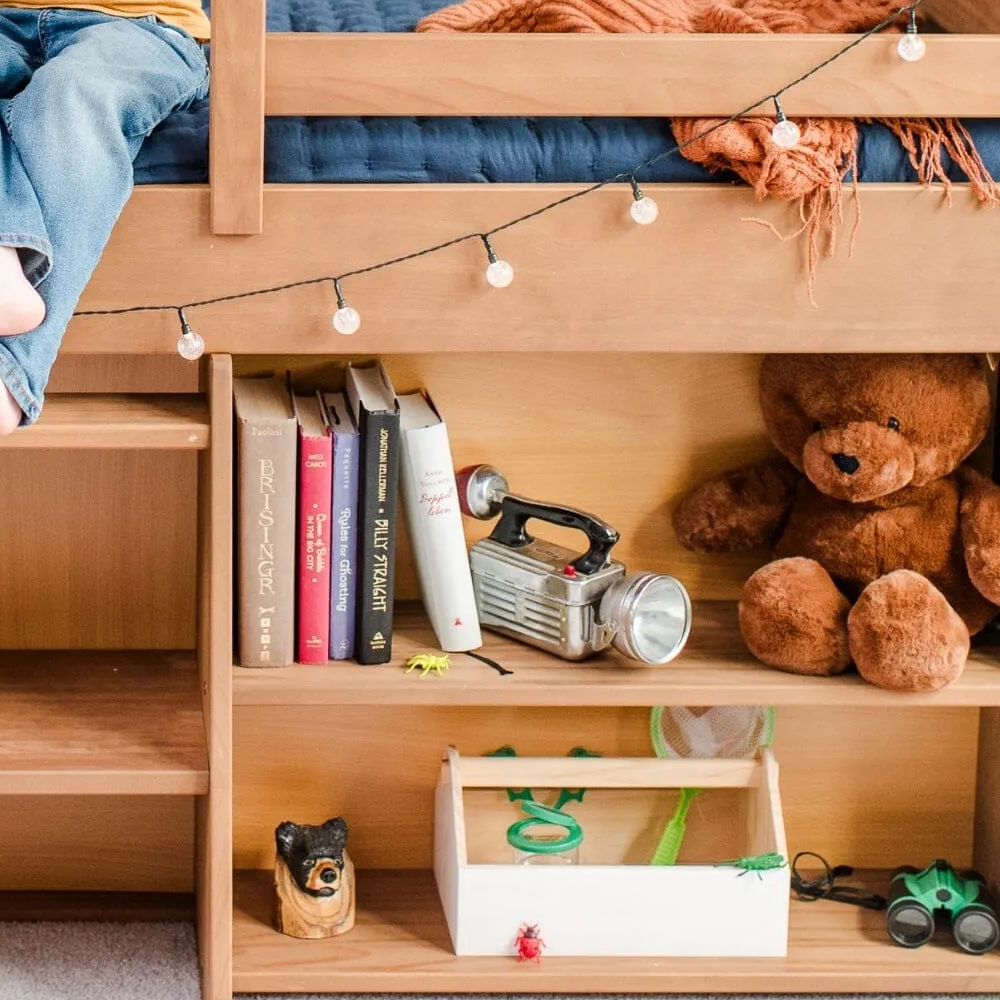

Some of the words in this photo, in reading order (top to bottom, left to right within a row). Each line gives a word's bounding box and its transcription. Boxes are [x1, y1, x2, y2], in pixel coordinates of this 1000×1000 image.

[252, 427, 282, 436] Paolini
[380, 428, 389, 462] JONATHAN
[305, 460, 328, 468] CABOT
[308, 453, 324, 461] MEG
[379, 464, 388, 502] KELLERMAN
[257, 458, 276, 595] BRISINGR
[307, 515, 315, 524] IN
[339, 507, 351, 542] Rules
[307, 525, 315, 539] THE
[374, 519, 389, 550] BILLY
[306, 540, 314, 553] BIG
[340, 544, 348, 557] for
[306, 554, 314, 571] CITY
[336, 559, 352, 612] Ghosting
[372, 554, 388, 613] STRAIGHT
